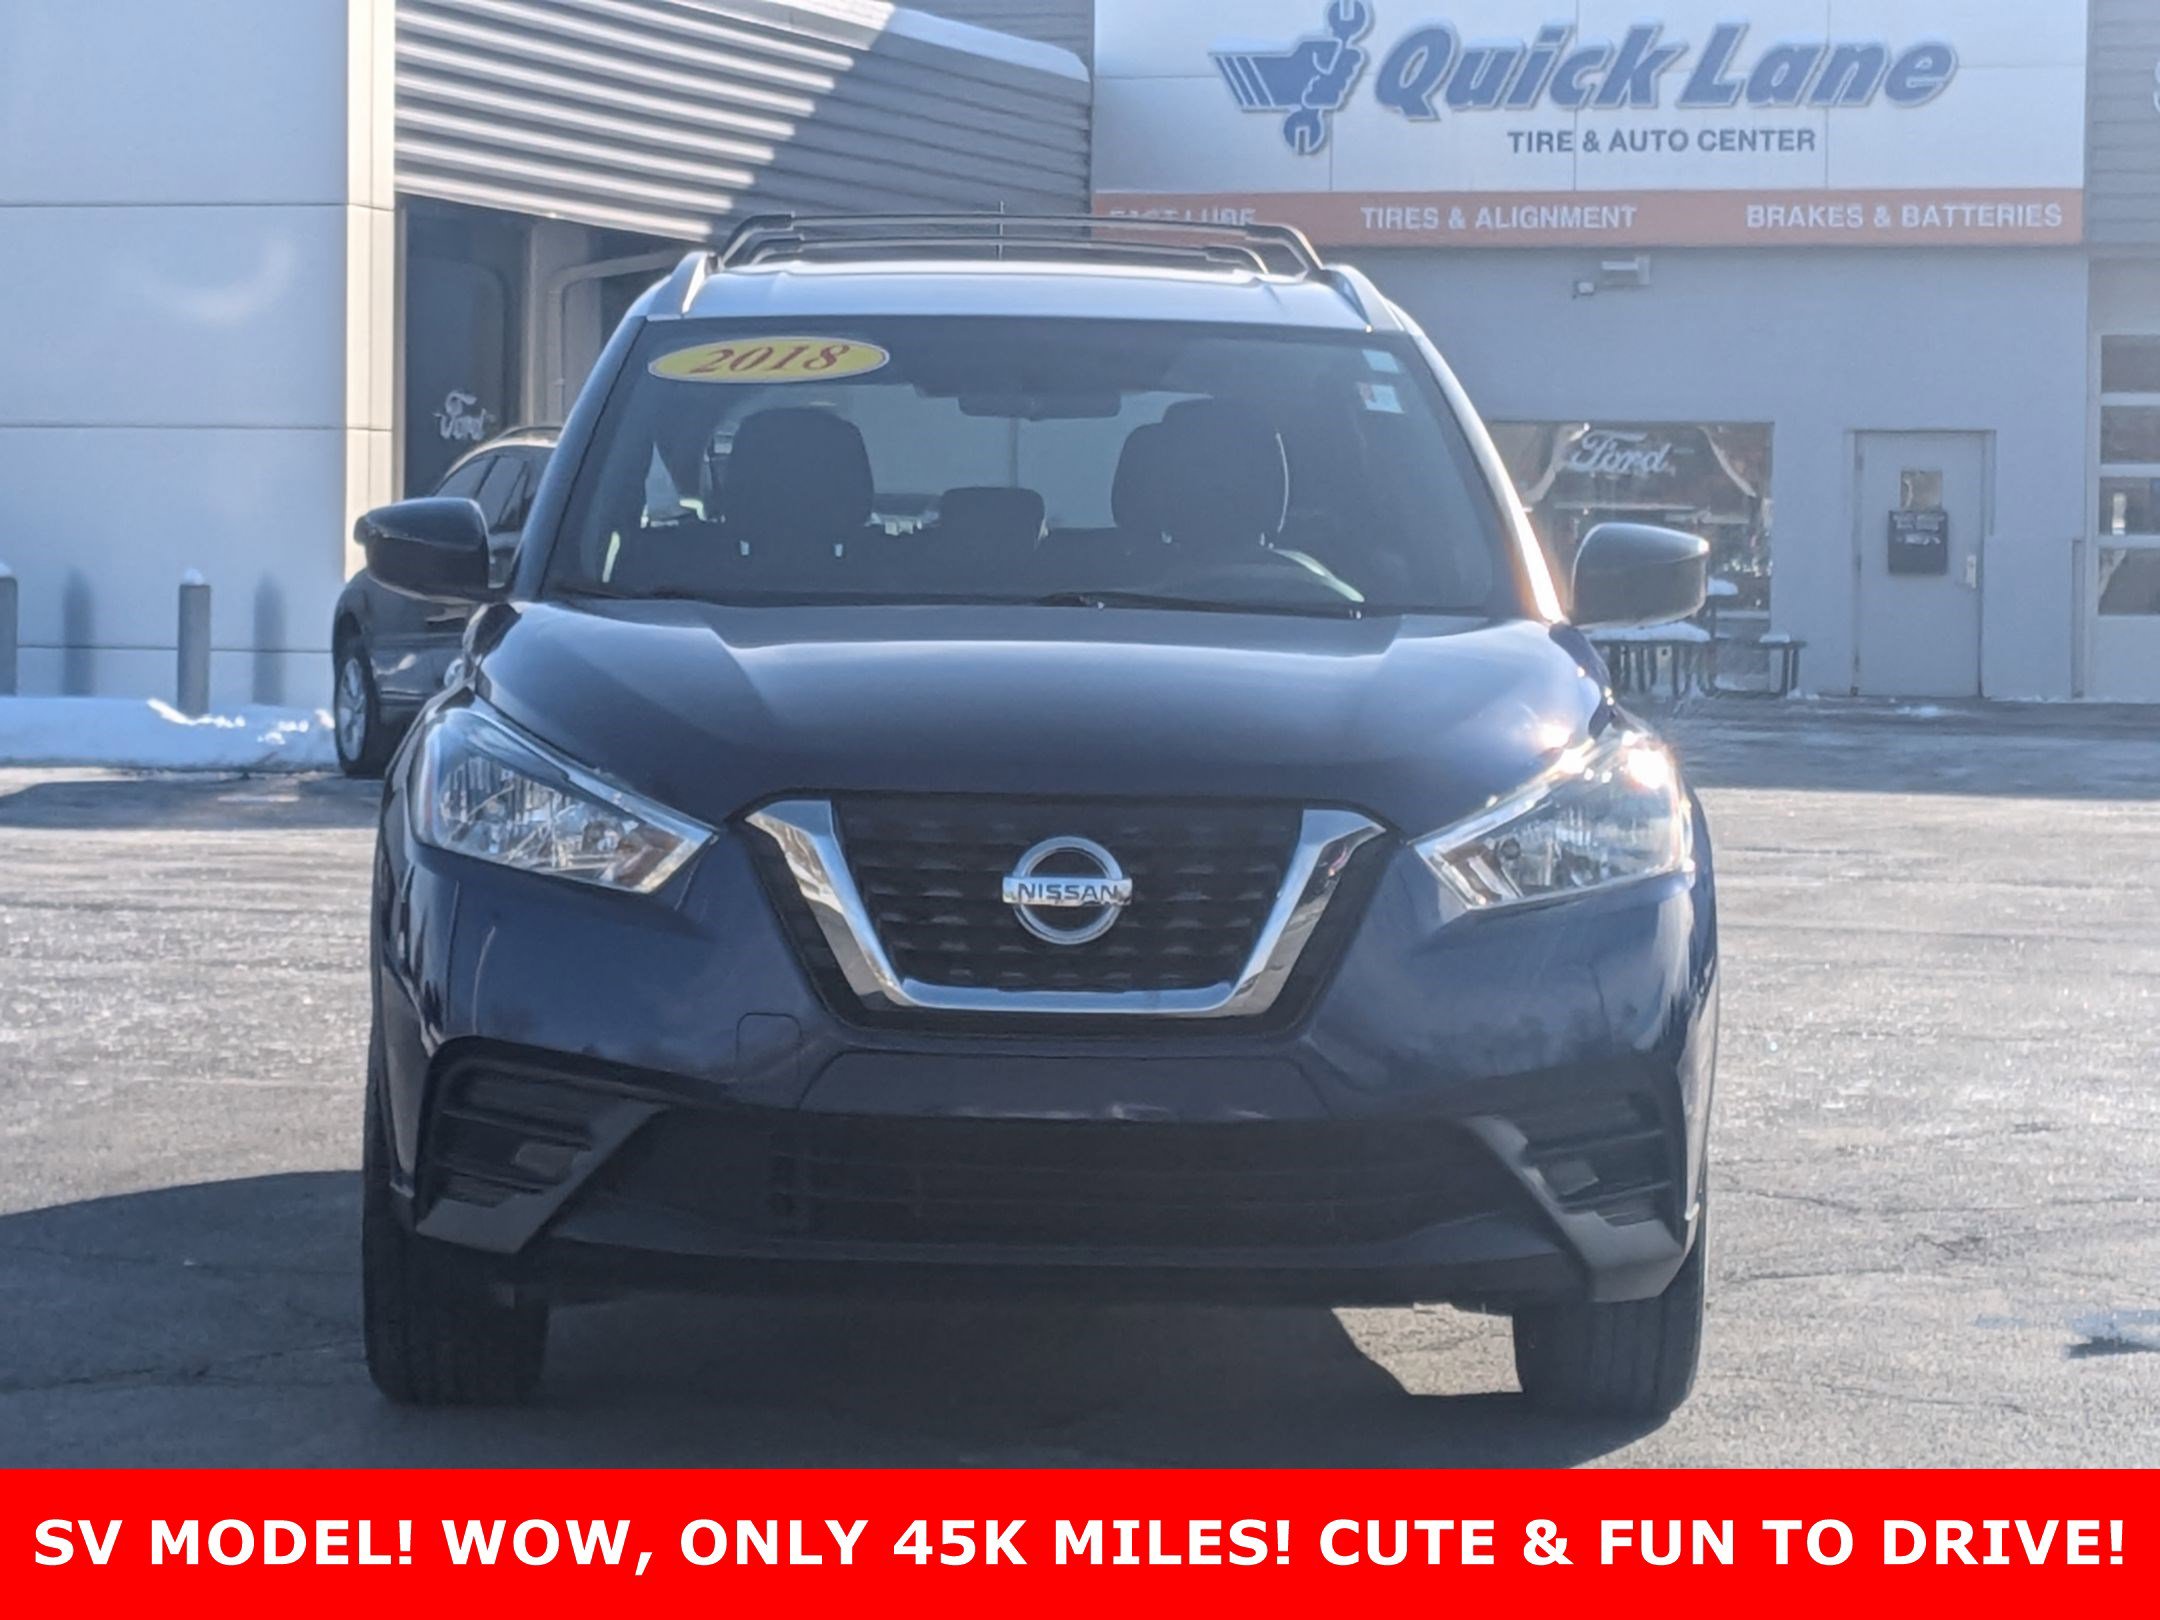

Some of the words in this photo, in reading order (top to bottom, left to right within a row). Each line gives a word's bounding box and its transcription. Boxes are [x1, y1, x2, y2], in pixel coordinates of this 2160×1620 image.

[1374, 21, 1688, 121] Quick
[1678, 21, 1958, 110] Lane
[1507, 129, 1574, 152] TIRE
[1582, 129, 1600, 152] &
[1608, 129, 1690, 152] AUTO
[1697, 129, 1816, 152] CENTER
[1360, 206, 1439, 230] TIRES
[1448, 206, 1466, 230] &
[1475, 205, 1637, 229] ALIGNMENT
[1746, 204, 1864, 228] BRAKES
[1873, 204, 1892, 228] &
[1901, 203, 2063, 228] BATTERIES
[689, 344, 850, 374] 2018
[1568, 430, 1674, 473] Ford
[1017, 882, 1119, 901] NISSAN
